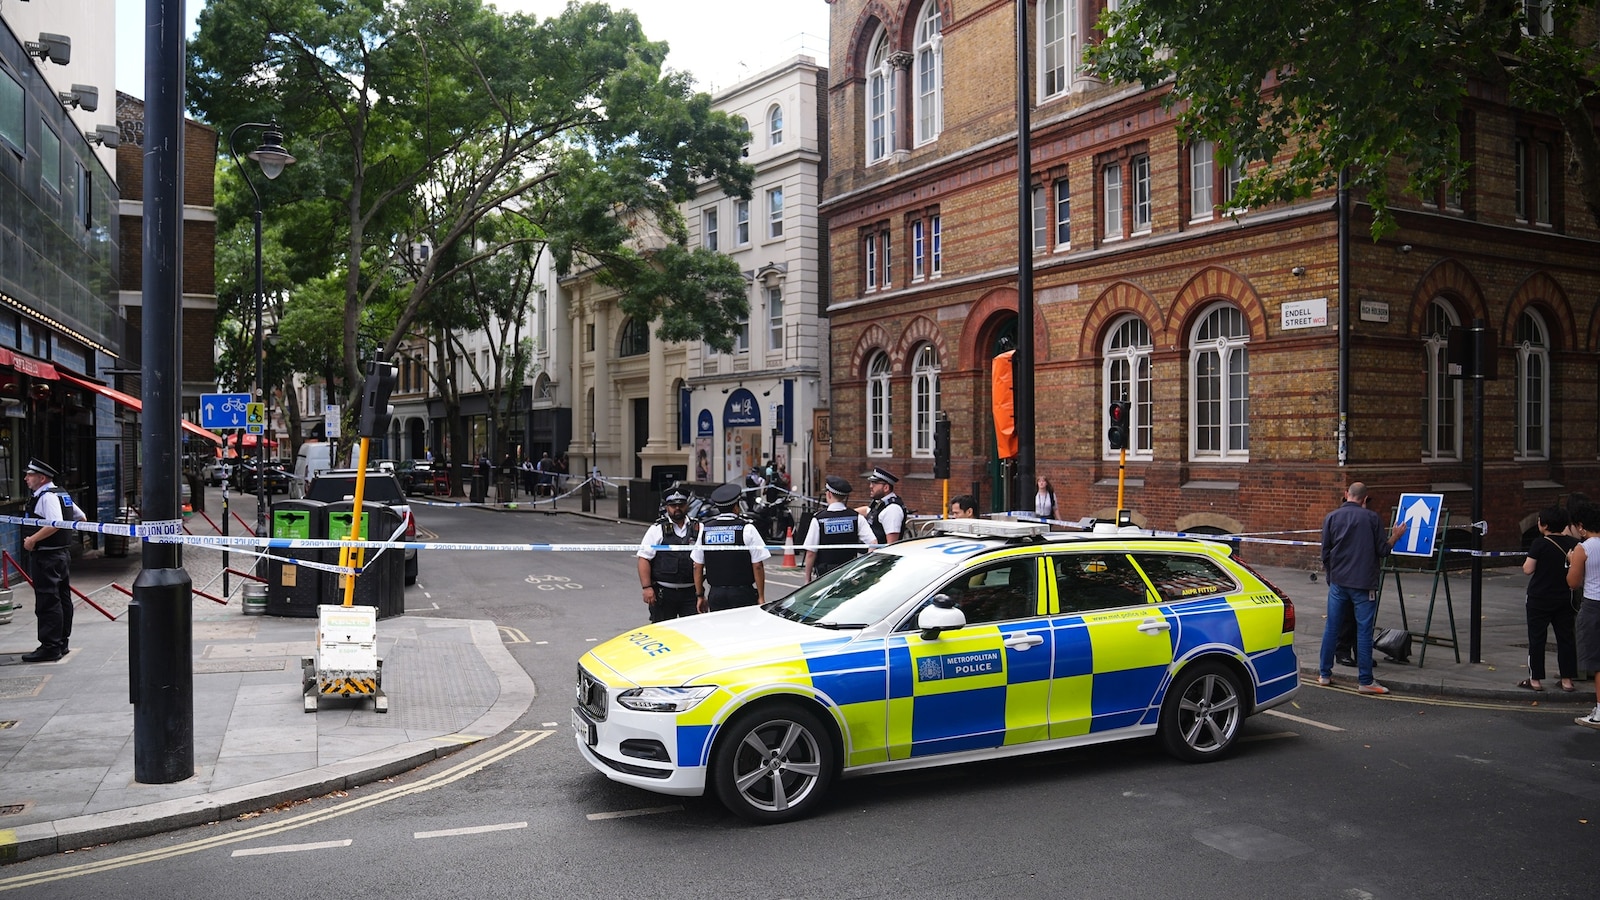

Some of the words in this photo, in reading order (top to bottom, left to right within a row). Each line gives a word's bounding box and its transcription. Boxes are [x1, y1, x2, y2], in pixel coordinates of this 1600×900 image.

[1285, 308, 1311, 317] ENDELL
[1371, 306, 1388, 316] HOLBORN
[1285, 317, 1312, 326] STREET
[1313, 316, 1326, 324] WC2
[148, 526, 162, 535] NOT
[164, 524, 175, 535] DO
[826, 523, 854, 533] POLICE
[706, 534, 734, 543] POLICE
[1181, 588, 1198, 596] ANPR
[1197, 585, 1218, 594] FITTED
[1250, 594, 1279, 605] LWM
[1092, 610, 1148, 621] www.met.police.uk
[629, 632, 671, 656] POLICE
[947, 652, 998, 665] METROPOLITAN
[955, 663, 992, 674] POLICE
